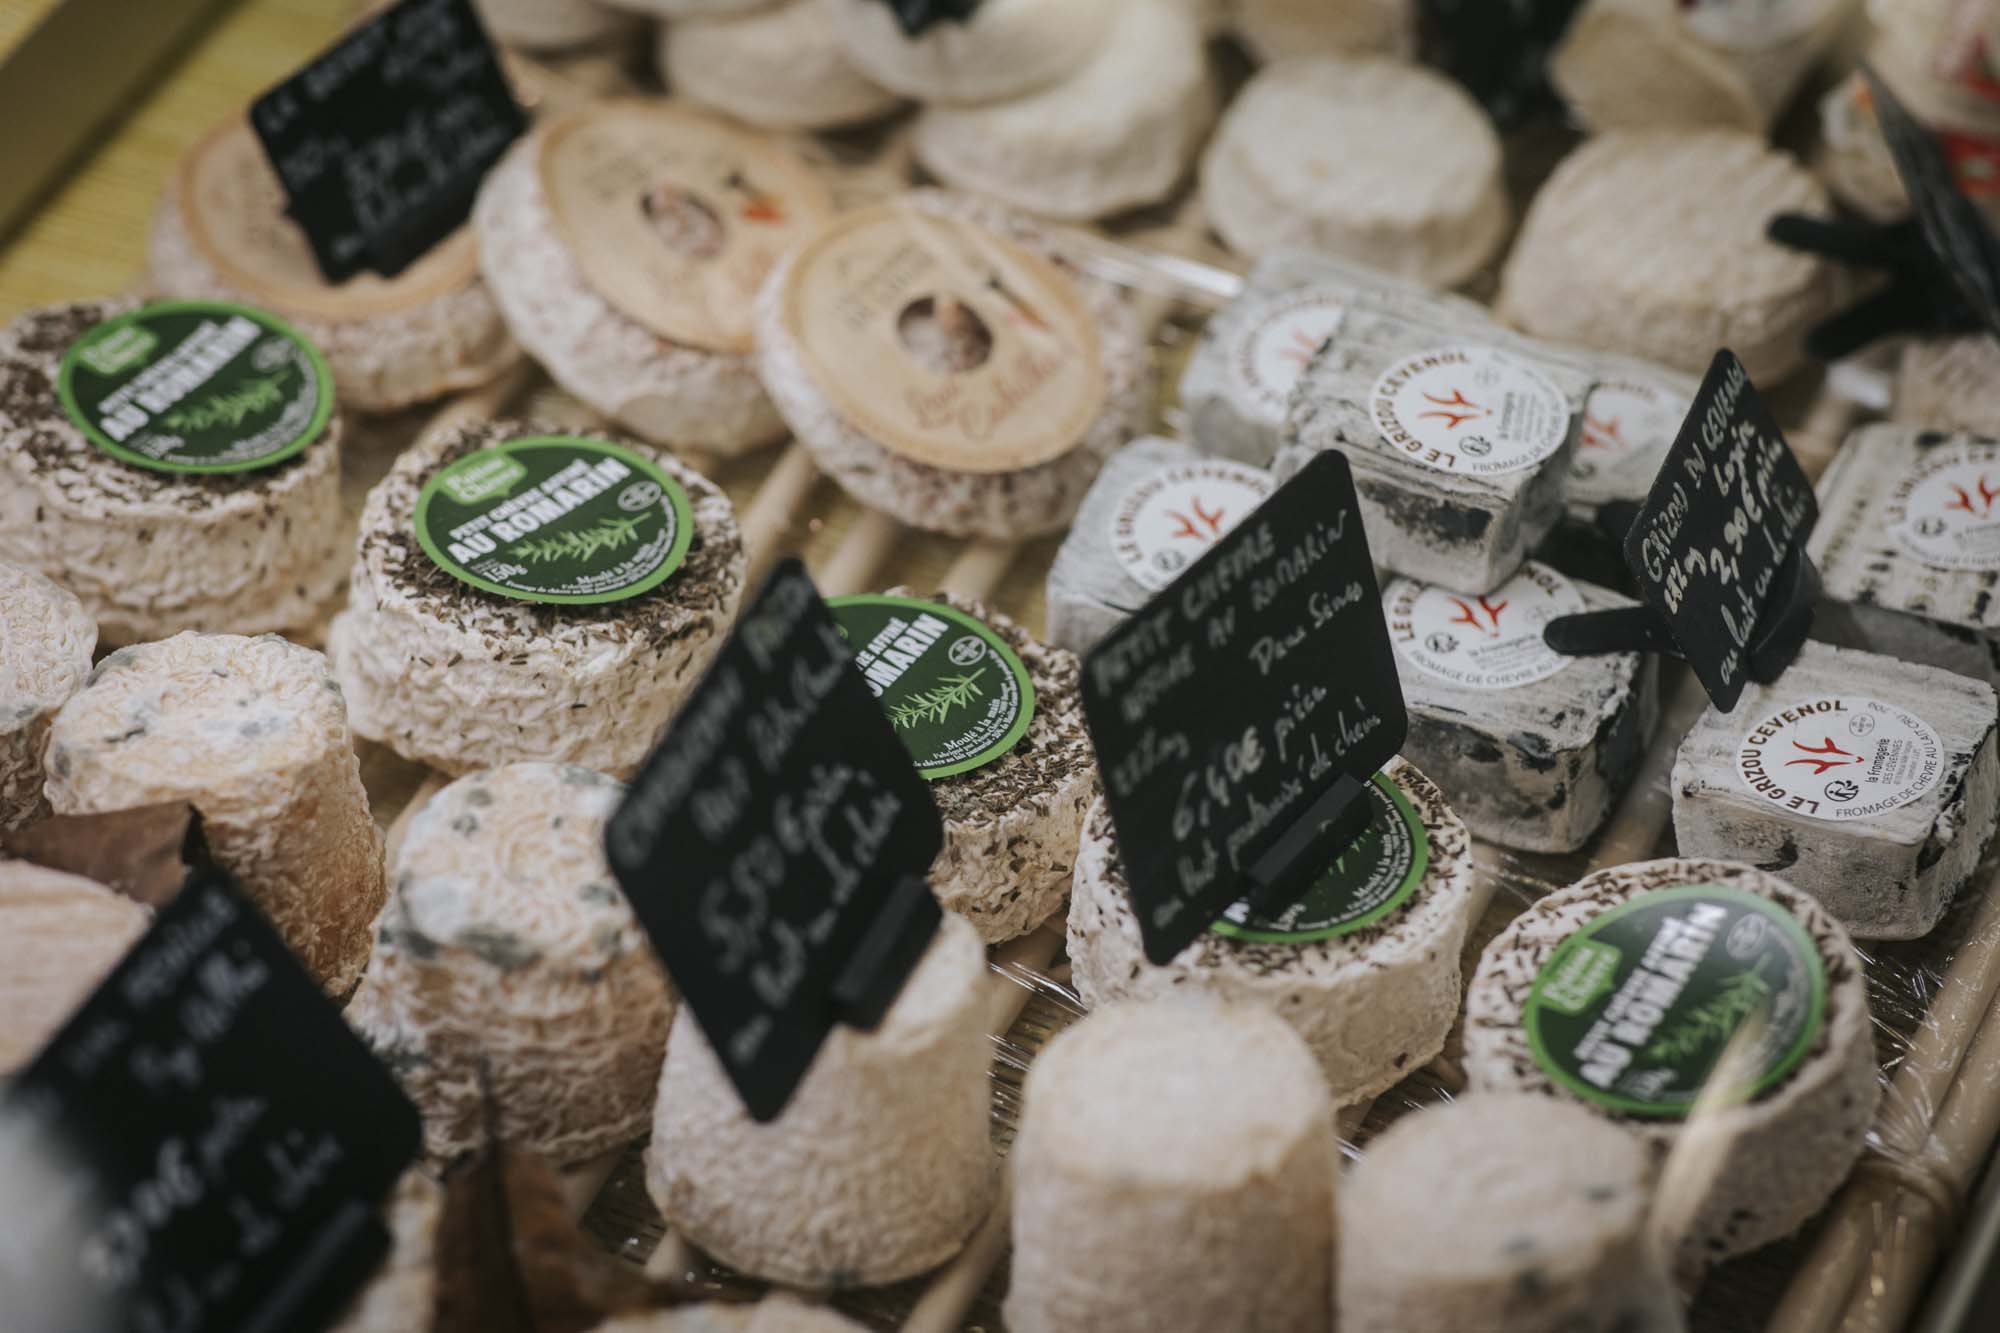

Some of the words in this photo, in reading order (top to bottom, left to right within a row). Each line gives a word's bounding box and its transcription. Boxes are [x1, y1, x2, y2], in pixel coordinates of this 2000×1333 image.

[1424, 447, 1457, 468] LE
[447, 533, 497, 565] AU
[488, 456, 632, 543] ROMARIN
[1392, 621, 1415, 642] LE
[943, 729, 978, 751] Moulé
[977, 718, 992, 728] la
[987, 698, 1001, 719] main
[1747, 700, 1849, 746] CEVENOL
[1913, 729, 1935, 748] LAIT
[1867, 737, 1891, 776] fromagerie
[1925, 747, 1938, 760] AU
[1741, 749, 1787, 801] GRIZOU
[1864, 775, 1879, 784] la
[1912, 760, 1937, 791] CHEVRE
[1898, 788, 1917, 800] DE
[1786, 796, 1820, 815] LE
[1836, 796, 1901, 817] FROMAGE
[1609, 902, 1728, 1047] ROMARIN
